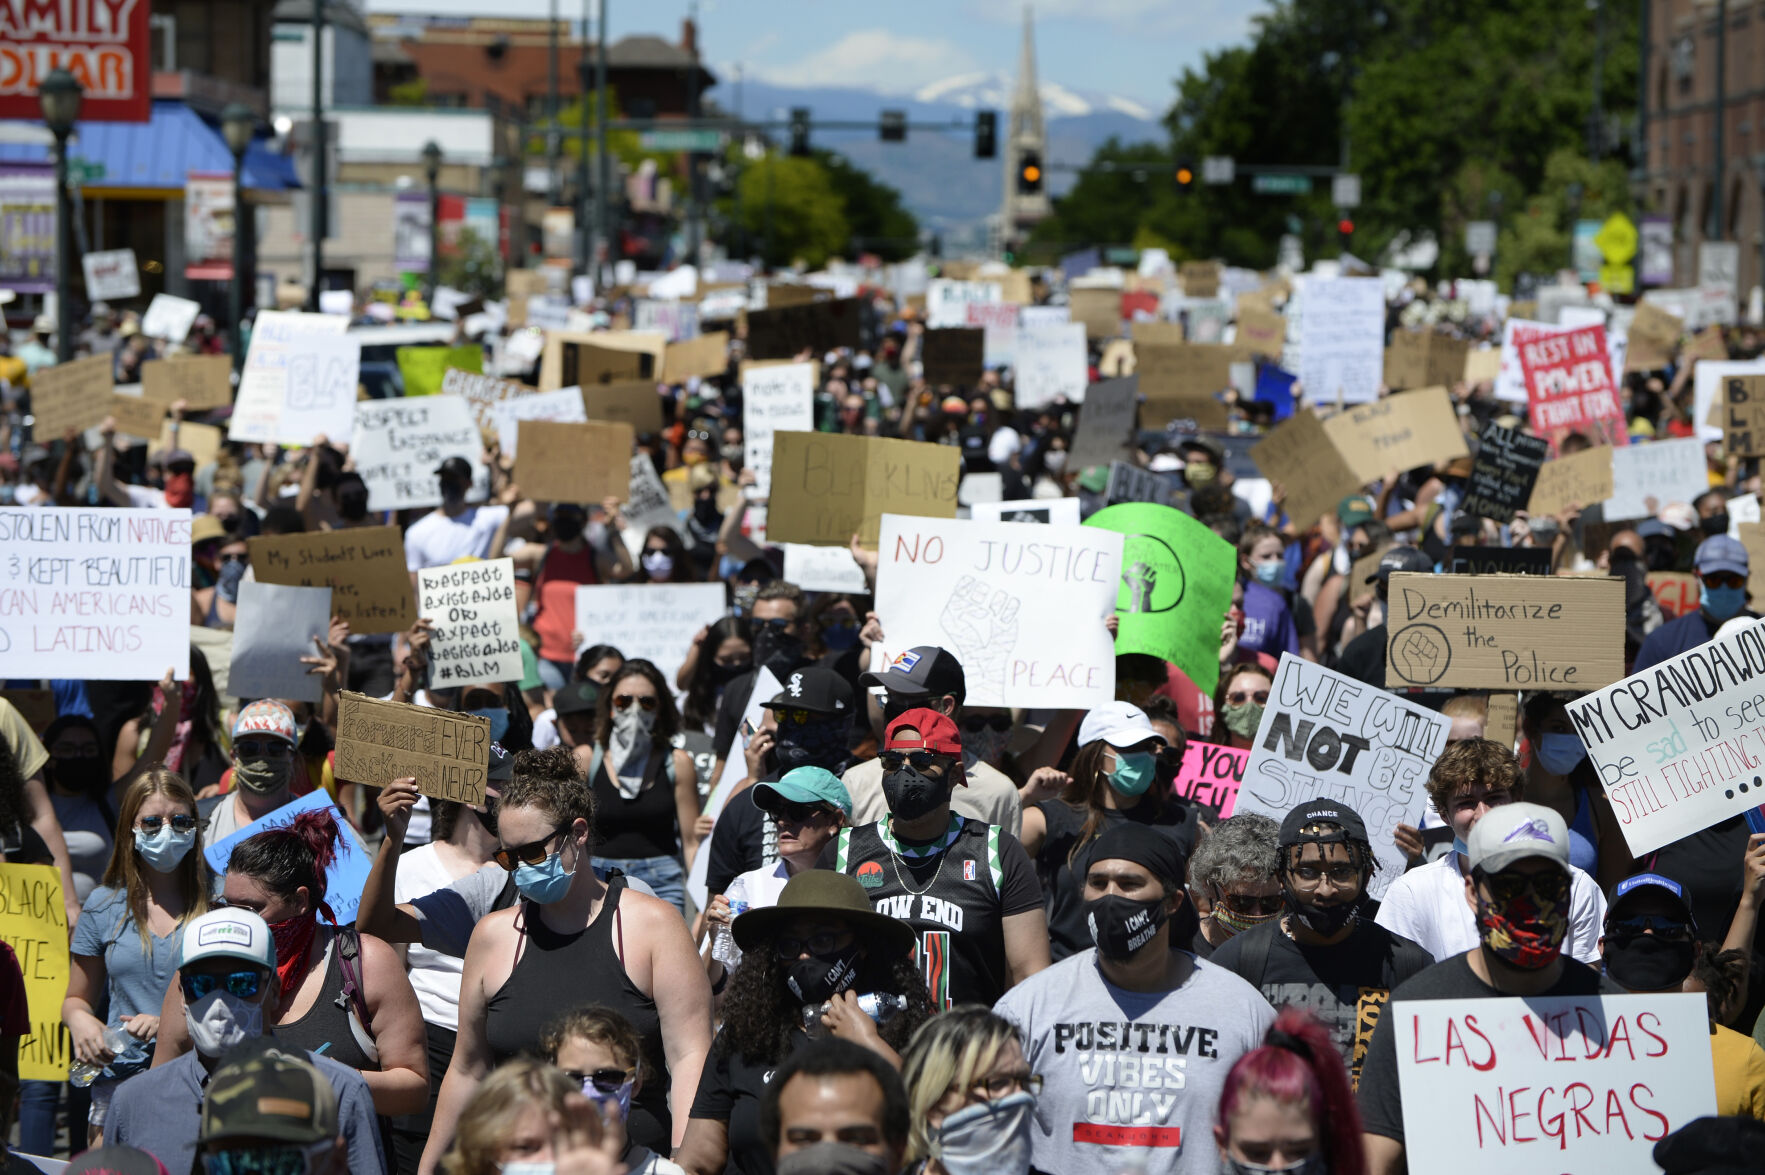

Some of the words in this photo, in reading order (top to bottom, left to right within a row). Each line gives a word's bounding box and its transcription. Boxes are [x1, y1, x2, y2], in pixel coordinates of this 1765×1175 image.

[1524, 336, 1570, 370] REST
[1571, 330, 1598, 358] IN
[1533, 361, 1610, 400] POWER
[1535, 396, 1582, 429] FIGHT
[0, 512, 69, 542] STOLEN
[78, 513, 121, 543] FROM
[128, 517, 192, 545] NATIVES
[28, 556, 74, 585] KEPT
[80, 555, 191, 588] BEAUTIFUL
[267, 550, 289, 569] My
[894, 533, 944, 564] NO
[974, 541, 1110, 584] JUSTICE
[51, 591, 173, 617] AMERICANS
[356, 596, 406, 619] listen!
[449, 607, 477, 622] OR
[1402, 587, 1563, 621] Demilitarize
[34, 625, 143, 653] LATINOS
[1463, 625, 1499, 648] the
[440, 661, 500, 680] #BLM
[1011, 659, 1103, 689] PEACE
[1502, 650, 1578, 684] Police
[1280, 660, 1362, 726] WE
[1361, 696, 1441, 764] WILL
[1570, 697, 1615, 748] MY
[343, 700, 439, 754] Forward
[441, 719, 486, 766] EVER
[1591, 753, 1639, 786] be
[1646, 718, 1688, 764] sad
[1690, 709, 1720, 742] to
[1200, 745, 1249, 783] YOU
[1263, 712, 1370, 776] NOT
[1368, 746, 1423, 804] BE
[441, 764, 483, 804] NEVER
[1611, 775, 1668, 824] STILL
[1661, 734, 1763, 802] FIGHTING
[1306, 810, 1339, 819] CHANCE
[920, 896, 963, 931] END
[1131, 909, 1150, 930] CAN'T
[1127, 924, 1158, 952] BREATHE
[1053, 1022, 1219, 1059] POSITIVE
[1413, 1014, 1496, 1072] LAS
[1522, 1006, 1668, 1061] VIDAS
[1079, 1054, 1187, 1089] VIBES
[1086, 1090, 1177, 1125] ONLY
[1474, 1082, 1669, 1150] NEGRAS
